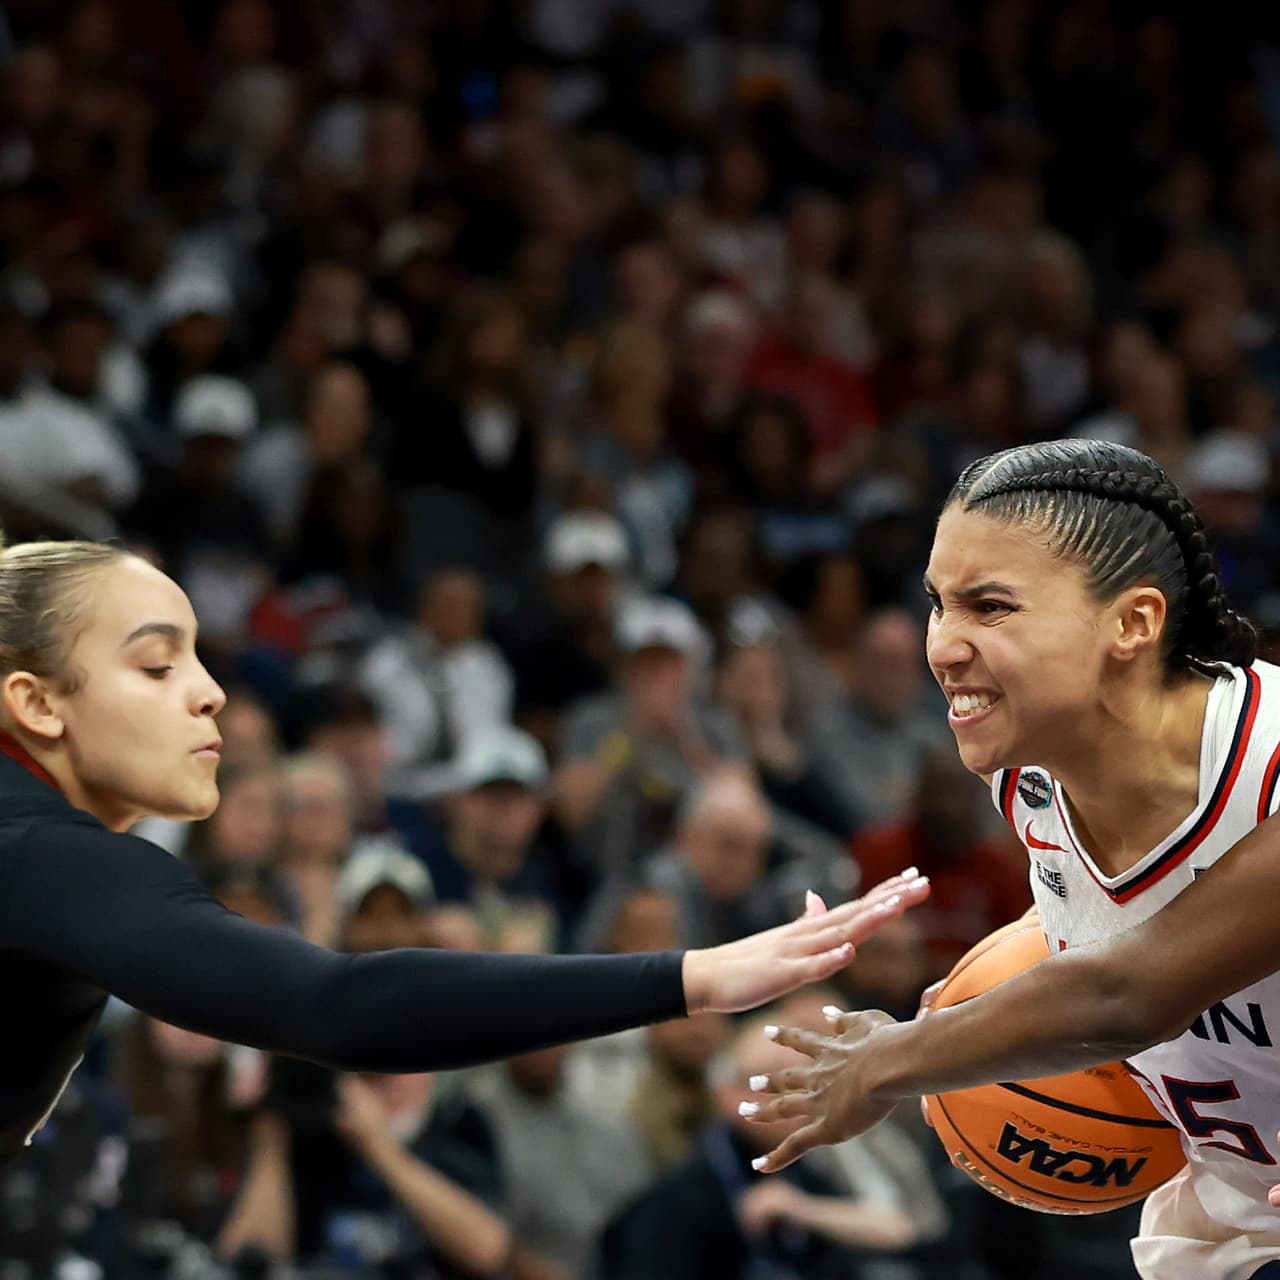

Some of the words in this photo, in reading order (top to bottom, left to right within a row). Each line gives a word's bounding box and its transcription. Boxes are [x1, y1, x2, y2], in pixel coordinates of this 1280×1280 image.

[1010, 1111, 1046, 1135] BALL
[1122, 1060, 1277, 1165] 5
[997, 1121, 1148, 1187] NCAA
